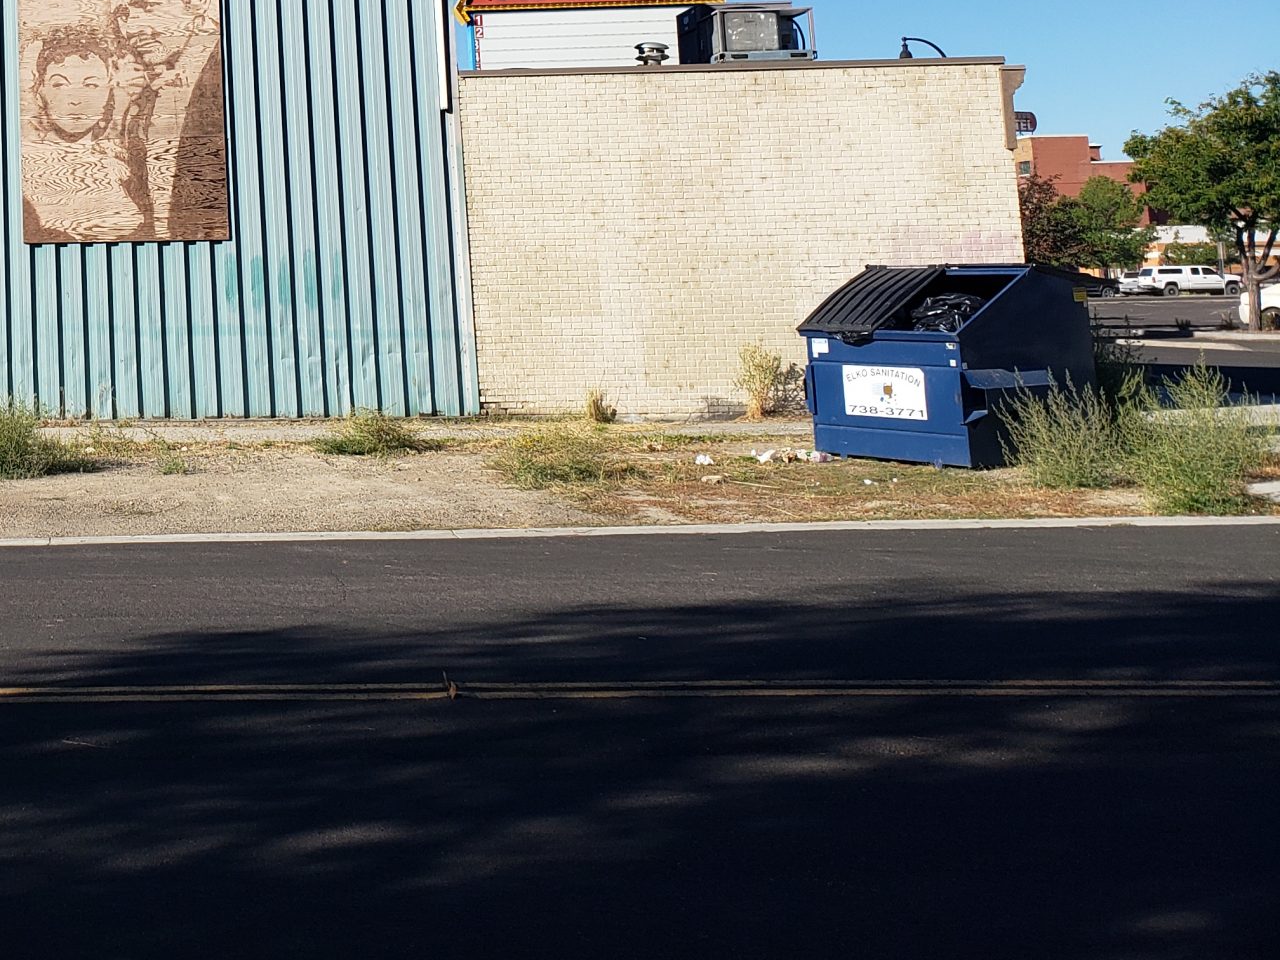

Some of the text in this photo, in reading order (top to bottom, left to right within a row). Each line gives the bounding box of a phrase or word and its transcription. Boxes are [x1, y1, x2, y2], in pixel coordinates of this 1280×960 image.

[846, 368, 921, 387] ELKO SANITATION
[849, 405, 924, 418] 738-3771
